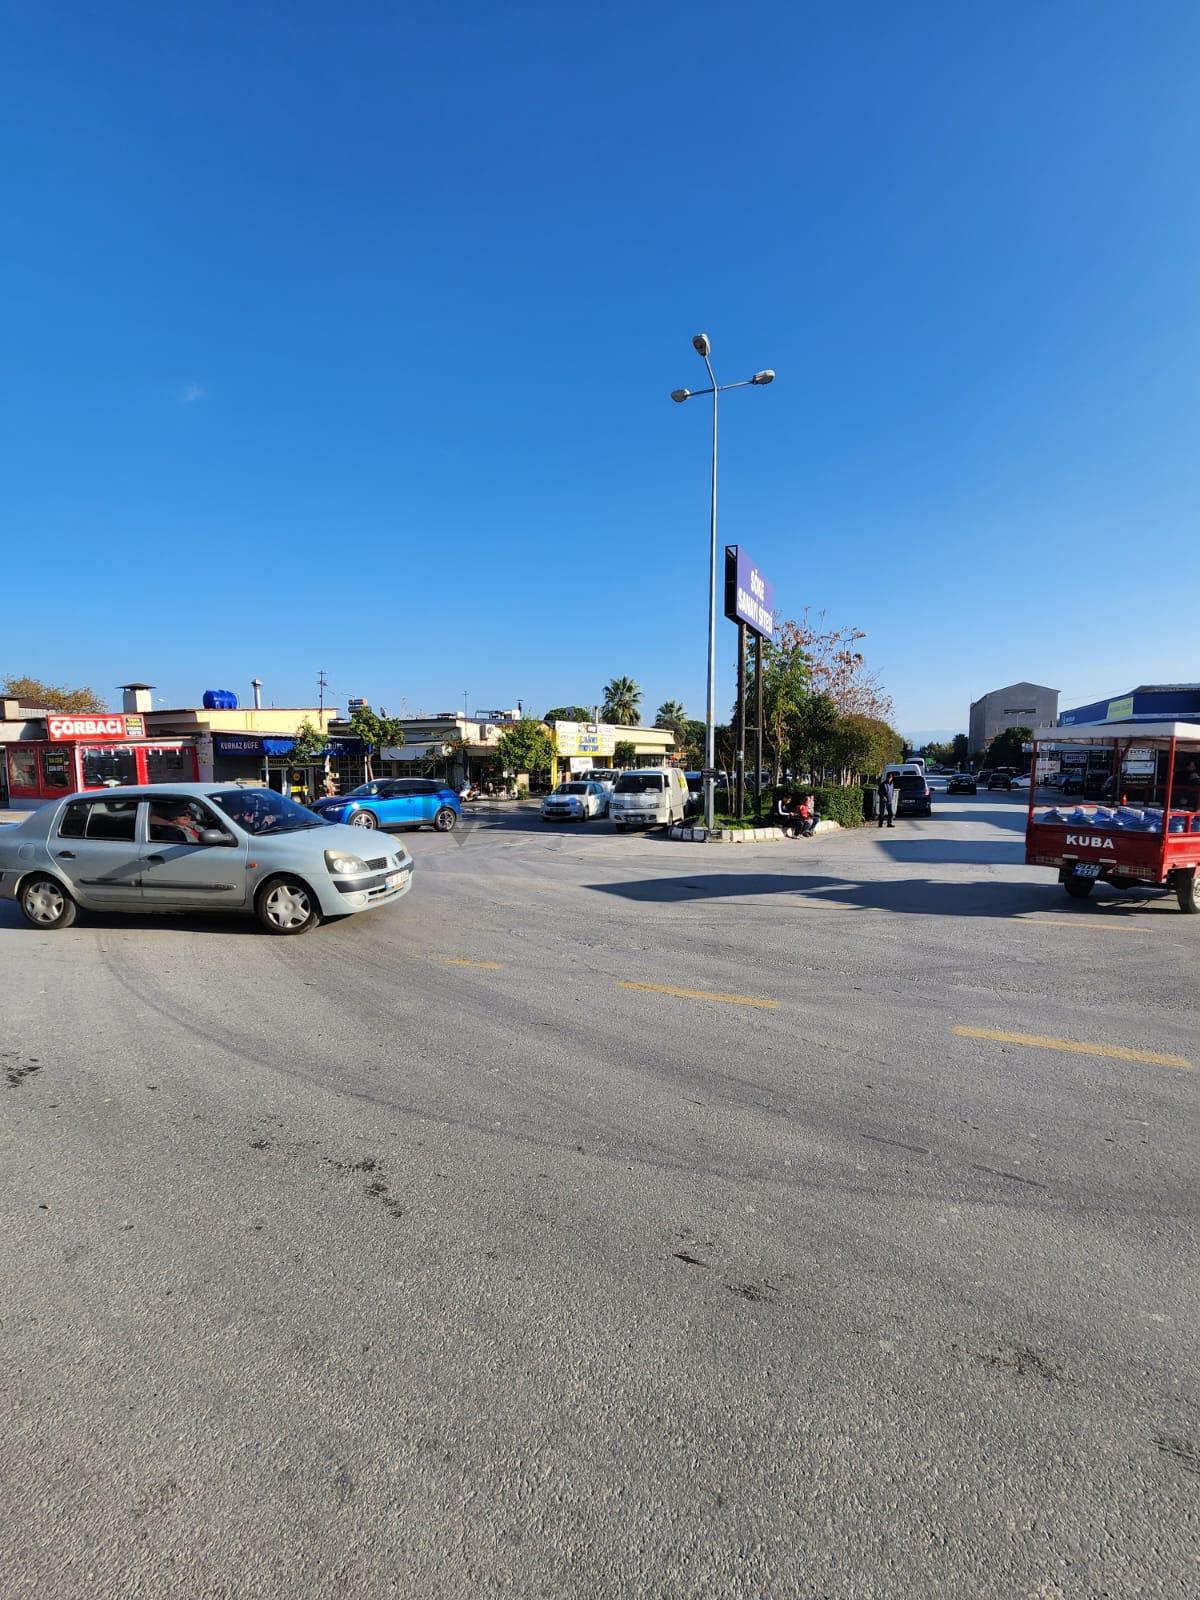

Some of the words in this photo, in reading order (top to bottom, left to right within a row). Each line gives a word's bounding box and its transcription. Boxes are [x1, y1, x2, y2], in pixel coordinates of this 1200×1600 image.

[750, 569, 765, 601] SÖKE
[738, 587, 759, 622] SANAYİ
[758, 604, 773, 634] SİTESİ
[50, 720, 123, 738] ÇORBACI
[1066, 834, 1114, 849] KUBA
